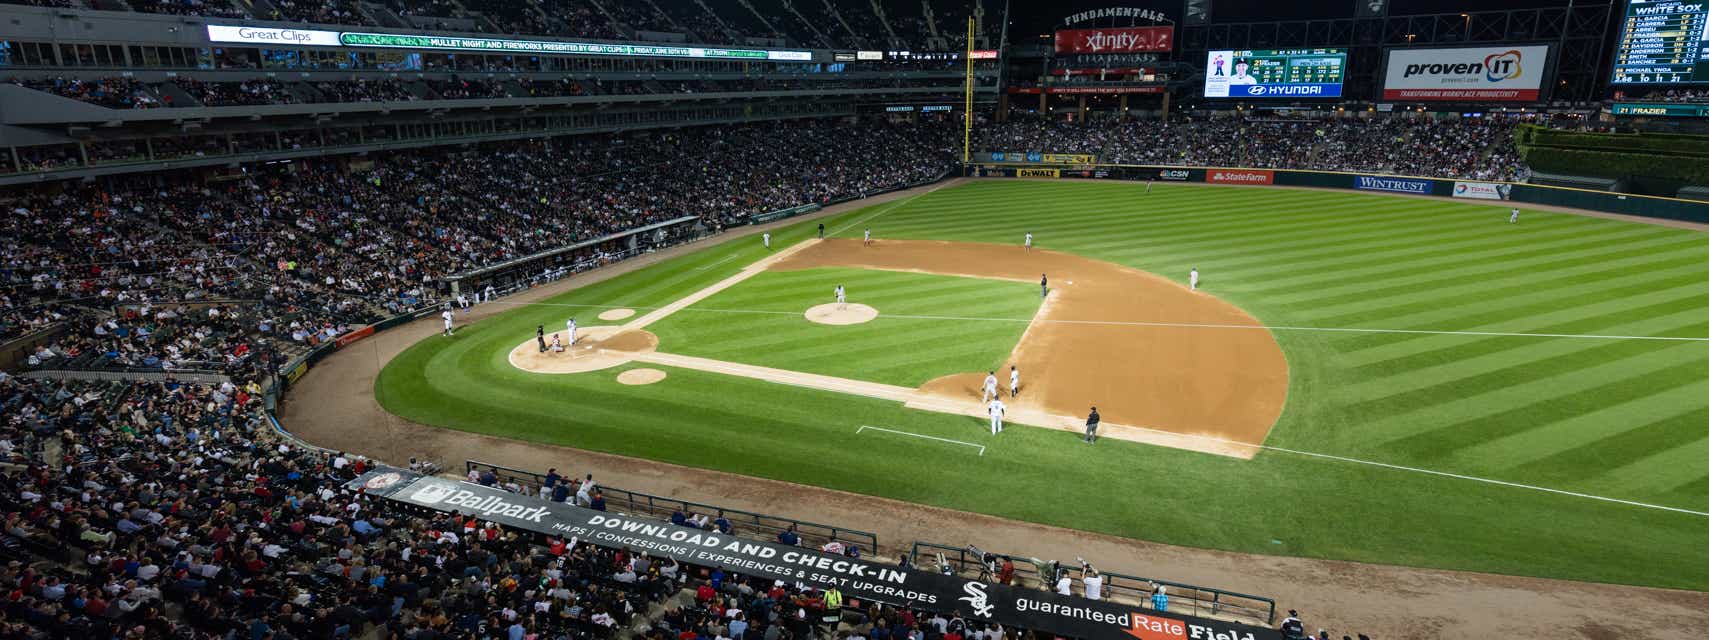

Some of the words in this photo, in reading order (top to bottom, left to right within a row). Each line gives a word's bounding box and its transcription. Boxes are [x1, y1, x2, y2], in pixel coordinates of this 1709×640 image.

[1636, 6, 1675, 15] WHITE
[1677, 3, 1702, 13] SOX
[1064, 7, 1165, 26] FUNDAMENTALS
[238, 27, 279, 41] Great
[280, 29, 311, 42] Clips
[1086, 31, 1139, 51] xfinity
[431, 38, 461, 47] MULLET
[462, 40, 486, 48] NIGHT
[486, 41, 502, 49] AND
[503, 41, 542, 50] FIREWORKS
[543, 43, 578, 51] PRESENTED
[1403, 62, 1483, 78] proven
[1494, 59, 1514, 74] IT
[1268, 85, 1322, 95] HYUNDAI
[1477, 90, 1519, 98] PRODUCTIVITY
[1632, 107, 1667, 115] FRAZIER
[1171, 170, 1189, 178] CSN
[1360, 177, 1427, 191] WINTRUST
[1471, 186, 1495, 194] TOTAL
[448, 488, 552, 524] Ballpark
[587, 514, 721, 548] DOWNLOAD
[723, 538, 777, 559] AND
[782, 550, 907, 585] CHECK-IN
[552, 522, 586, 537] MAPS
[596, 531, 688, 556] CONCESSIONS
[698, 550, 794, 576] EXPERIENCES
[795, 568, 806, 578] &
[808, 572, 849, 587] SEAT
[851, 580, 937, 605] UPGRADES
[1016, 597, 1129, 628] guaranteed
[1133, 614, 1184, 637] Rate
